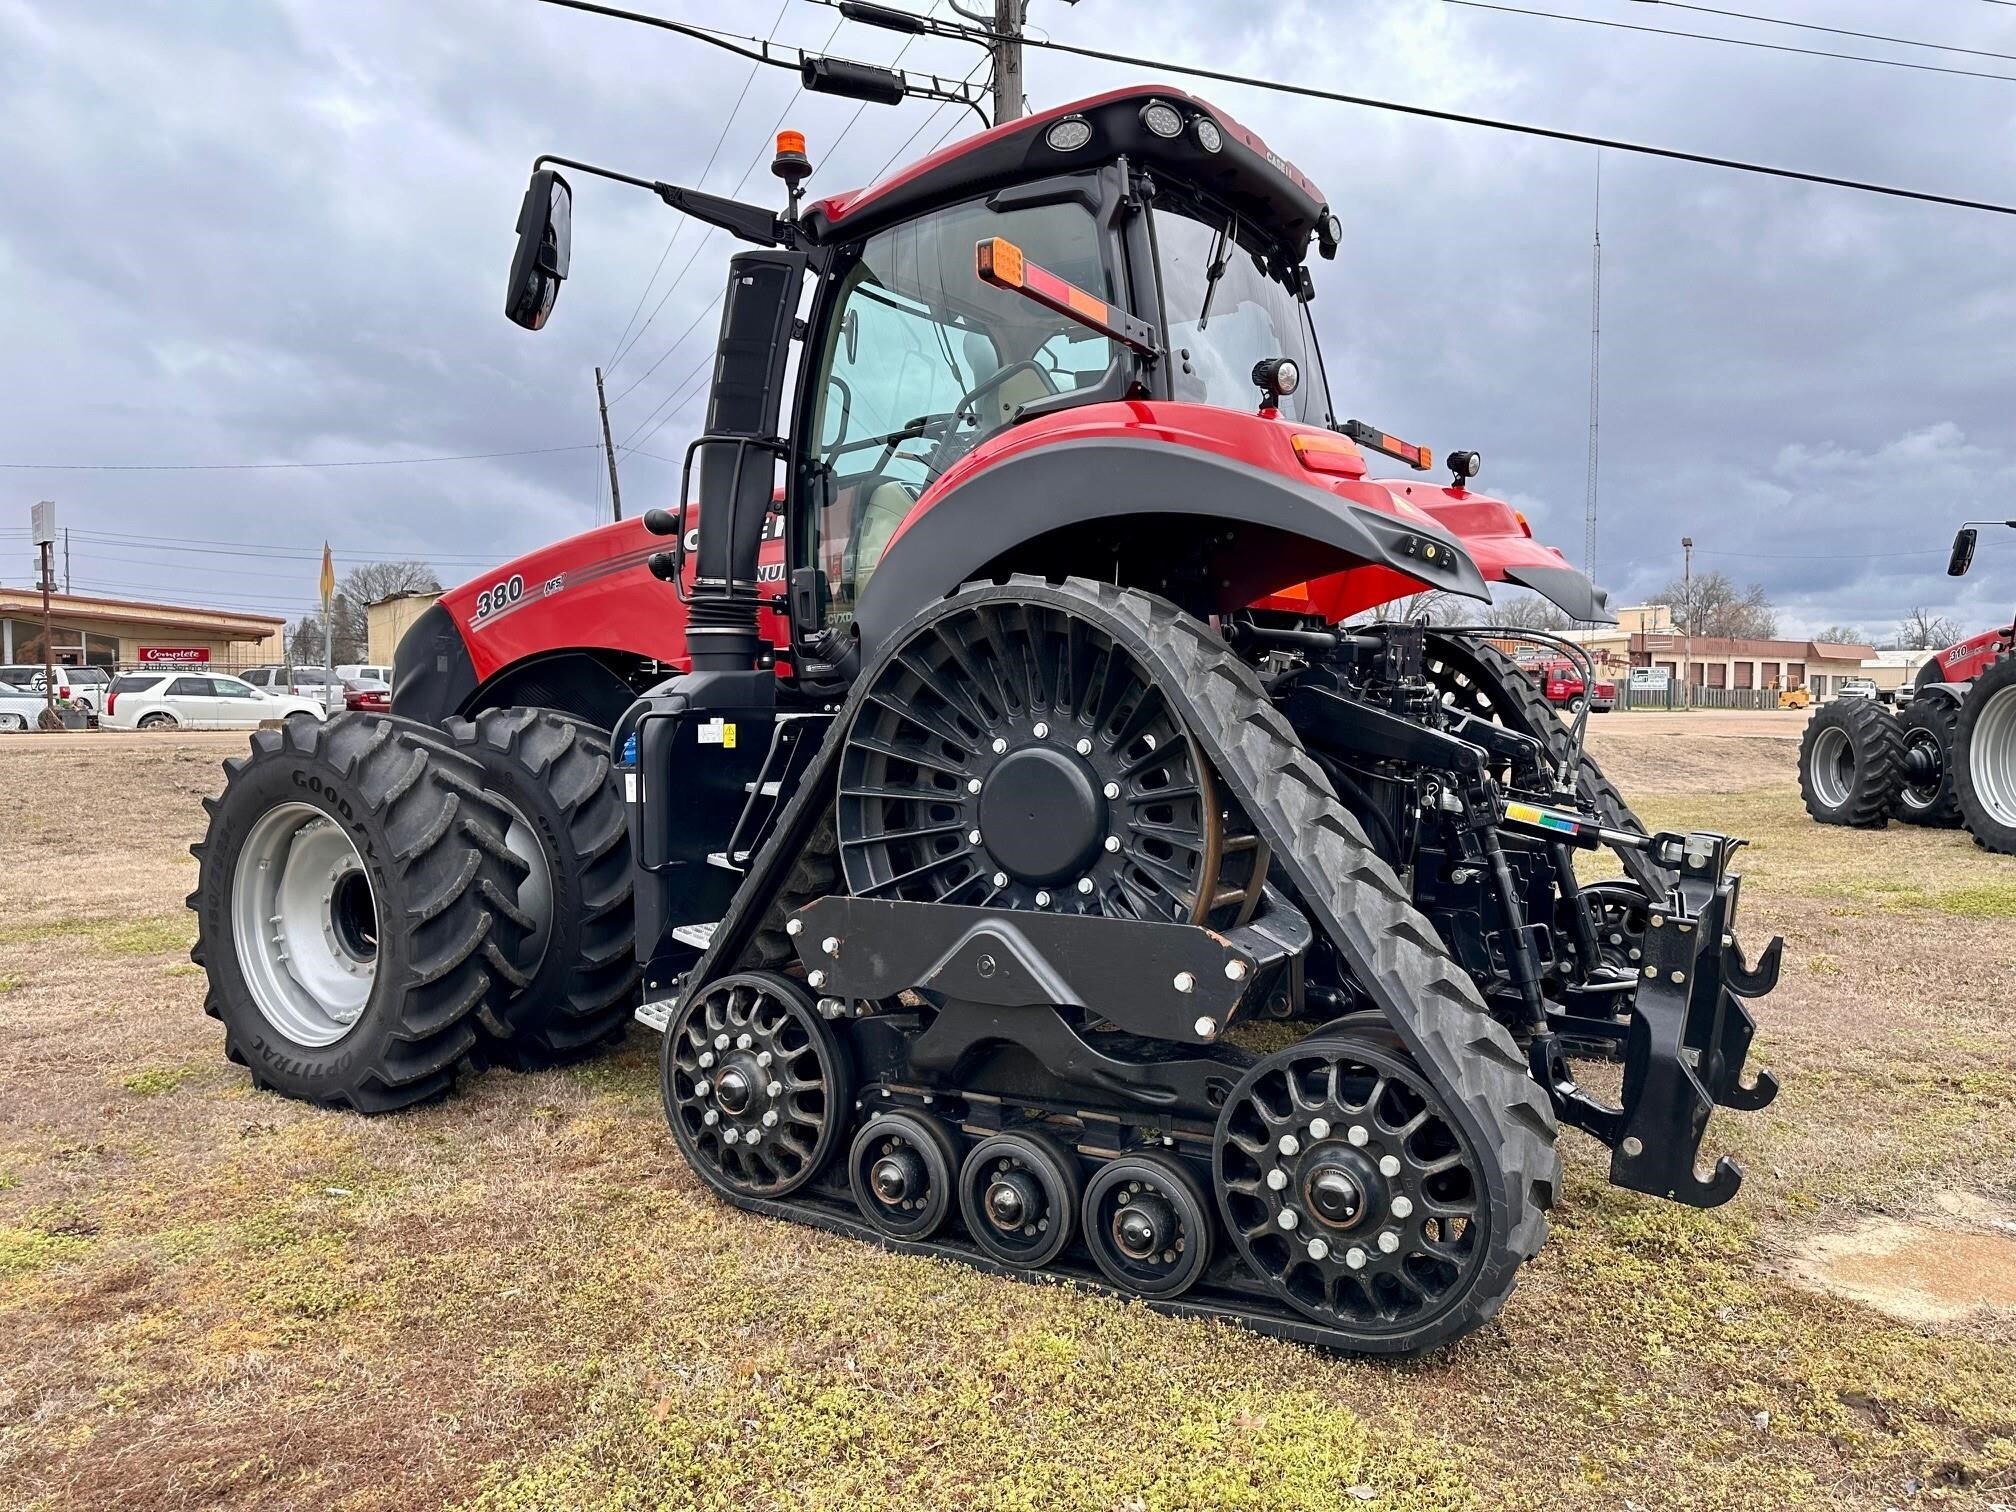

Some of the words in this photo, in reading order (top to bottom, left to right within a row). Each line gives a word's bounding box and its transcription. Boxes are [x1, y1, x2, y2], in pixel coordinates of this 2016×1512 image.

[544, 575, 563, 592] AFS
[477, 574, 524, 618] 380
[146, 649, 200, 661] Complete
[1950, 645, 1967, 662] 310
[144, 663, 168, 671] Auto
[250, 1034, 353, 1079] OPTITRAC
